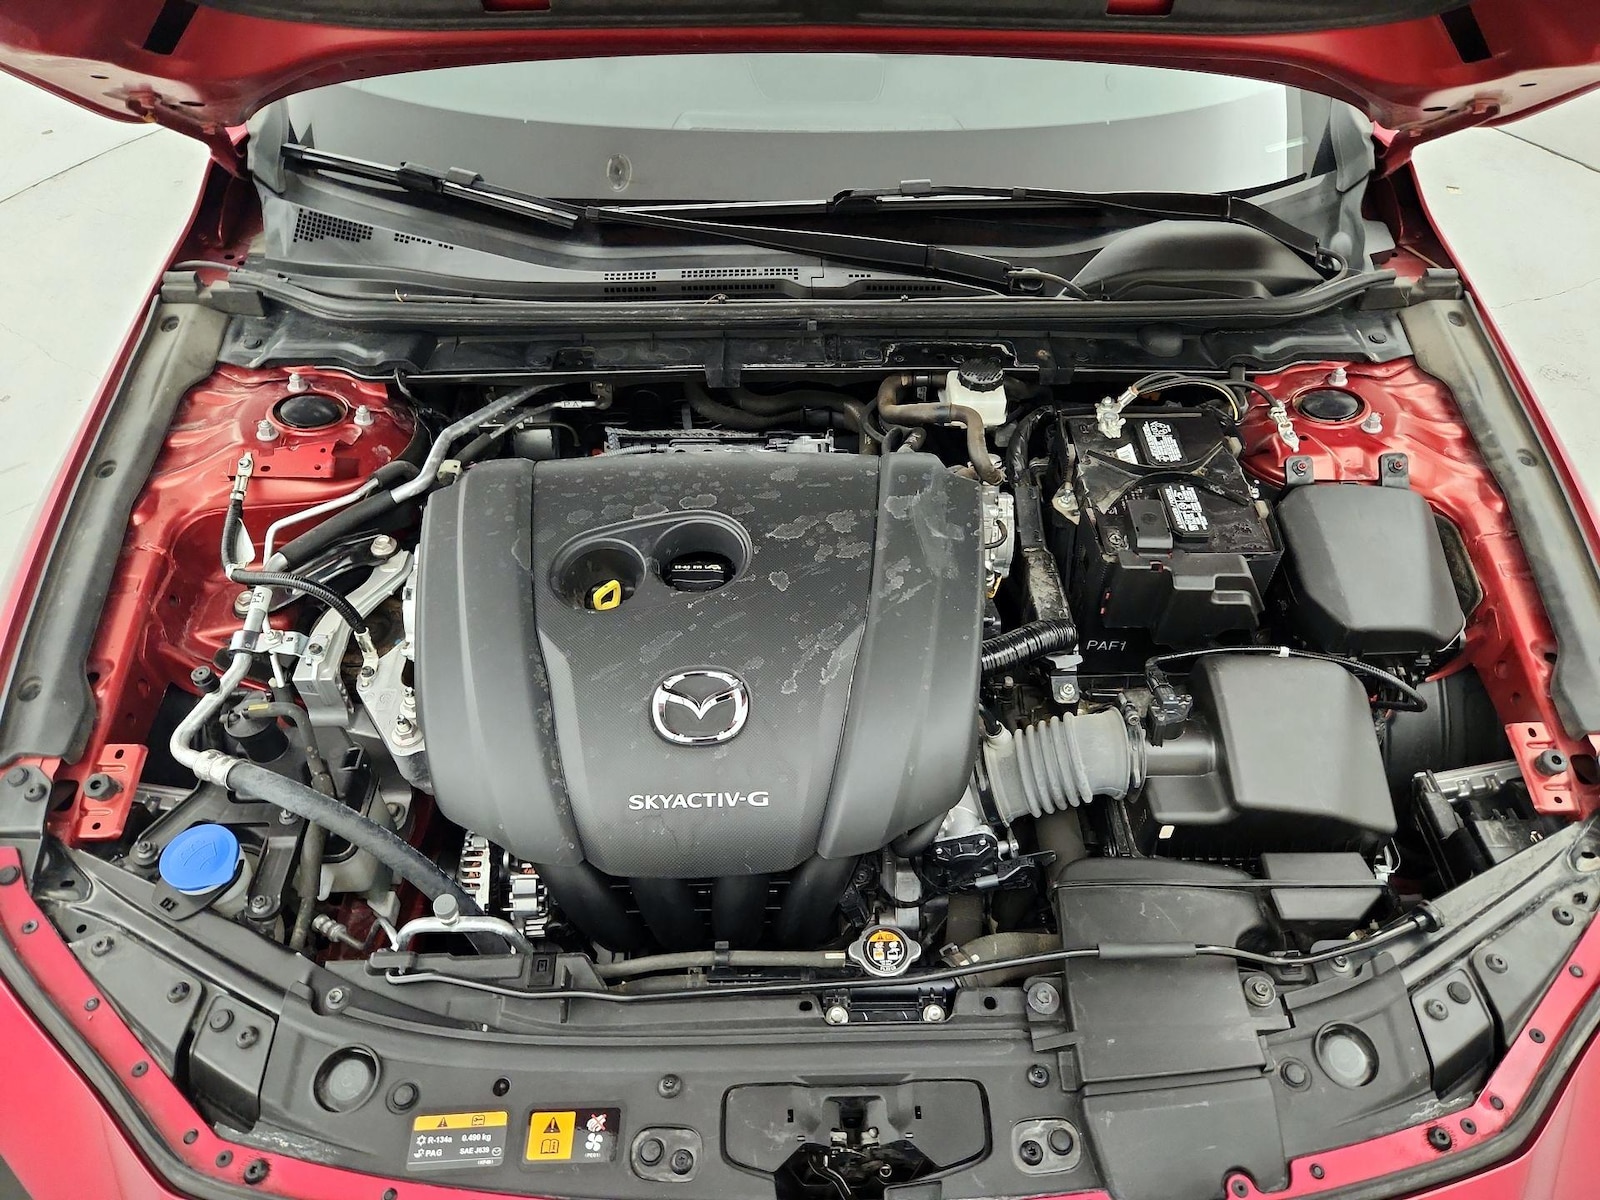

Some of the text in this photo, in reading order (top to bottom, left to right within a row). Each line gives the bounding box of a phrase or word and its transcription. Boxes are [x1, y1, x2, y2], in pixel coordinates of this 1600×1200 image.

[1086, 639, 1127, 651] PAF1
[628, 791, 769, 810] SKYACTIV-G
[427, 1135, 453, 1144] R-134a
[481, 1132, 492, 1142] kg
[425, 1148, 443, 1157] PAG
[459, 1147, 474, 1155] SAE
